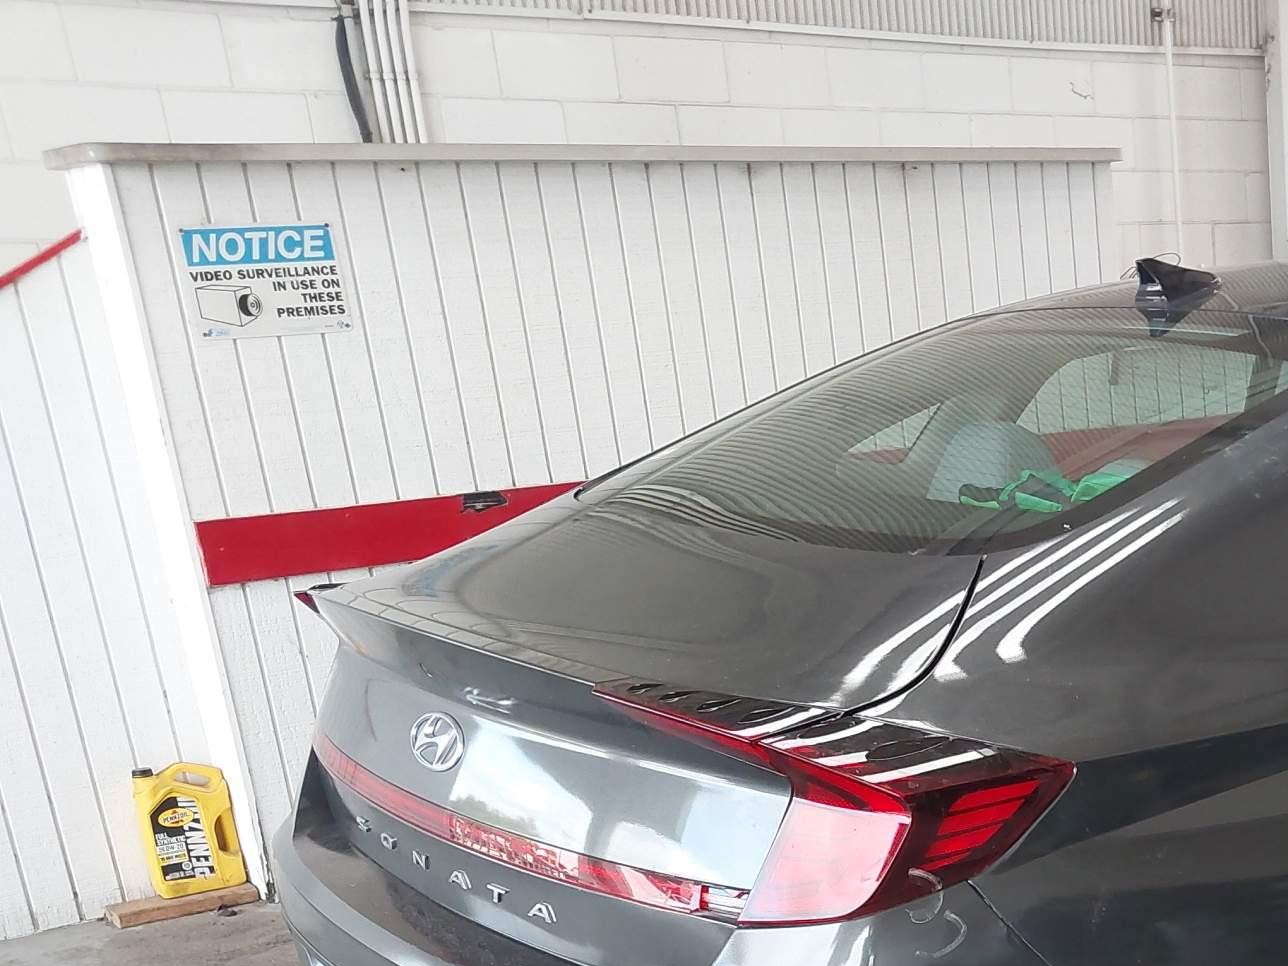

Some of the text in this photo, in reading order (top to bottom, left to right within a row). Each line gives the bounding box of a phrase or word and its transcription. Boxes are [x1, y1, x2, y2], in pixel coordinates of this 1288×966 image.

[192, 229, 325, 263] NOTICE
[189, 265, 338, 282] VIDEO SURVEILLANCE
[272, 278, 340, 291] IN USE ON
[301, 291, 344, 303] THESE
[277, 304, 346, 318] PREMISES
[176, 796, 213, 877] PENNZI
[355, 815, 557, 924] SONATA
